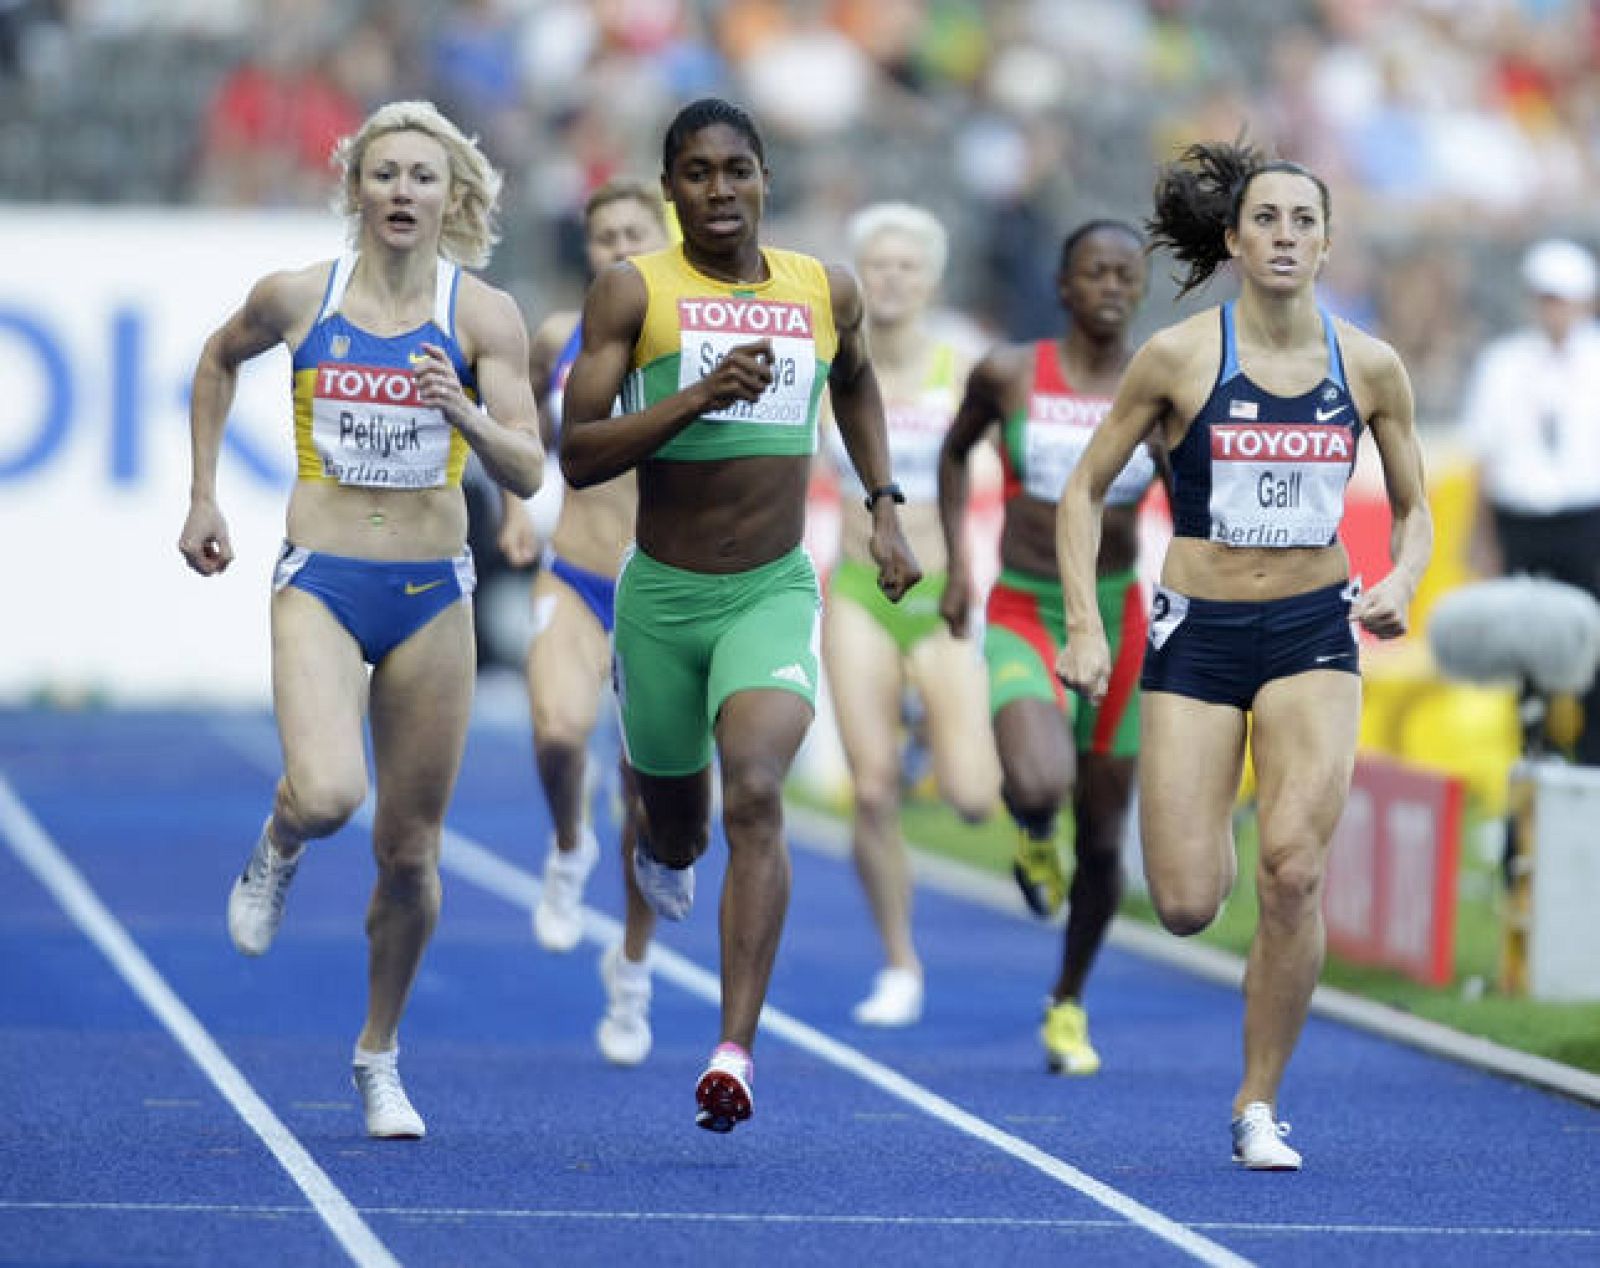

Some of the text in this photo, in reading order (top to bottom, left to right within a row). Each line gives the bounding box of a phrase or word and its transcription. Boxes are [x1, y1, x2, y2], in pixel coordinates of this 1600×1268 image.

[679, 301, 808, 333] TOYOTA
[320, 368, 422, 401] TOYO
[1216, 430, 1348, 458] TOYOTA
[1257, 471, 1303, 508] Gall
